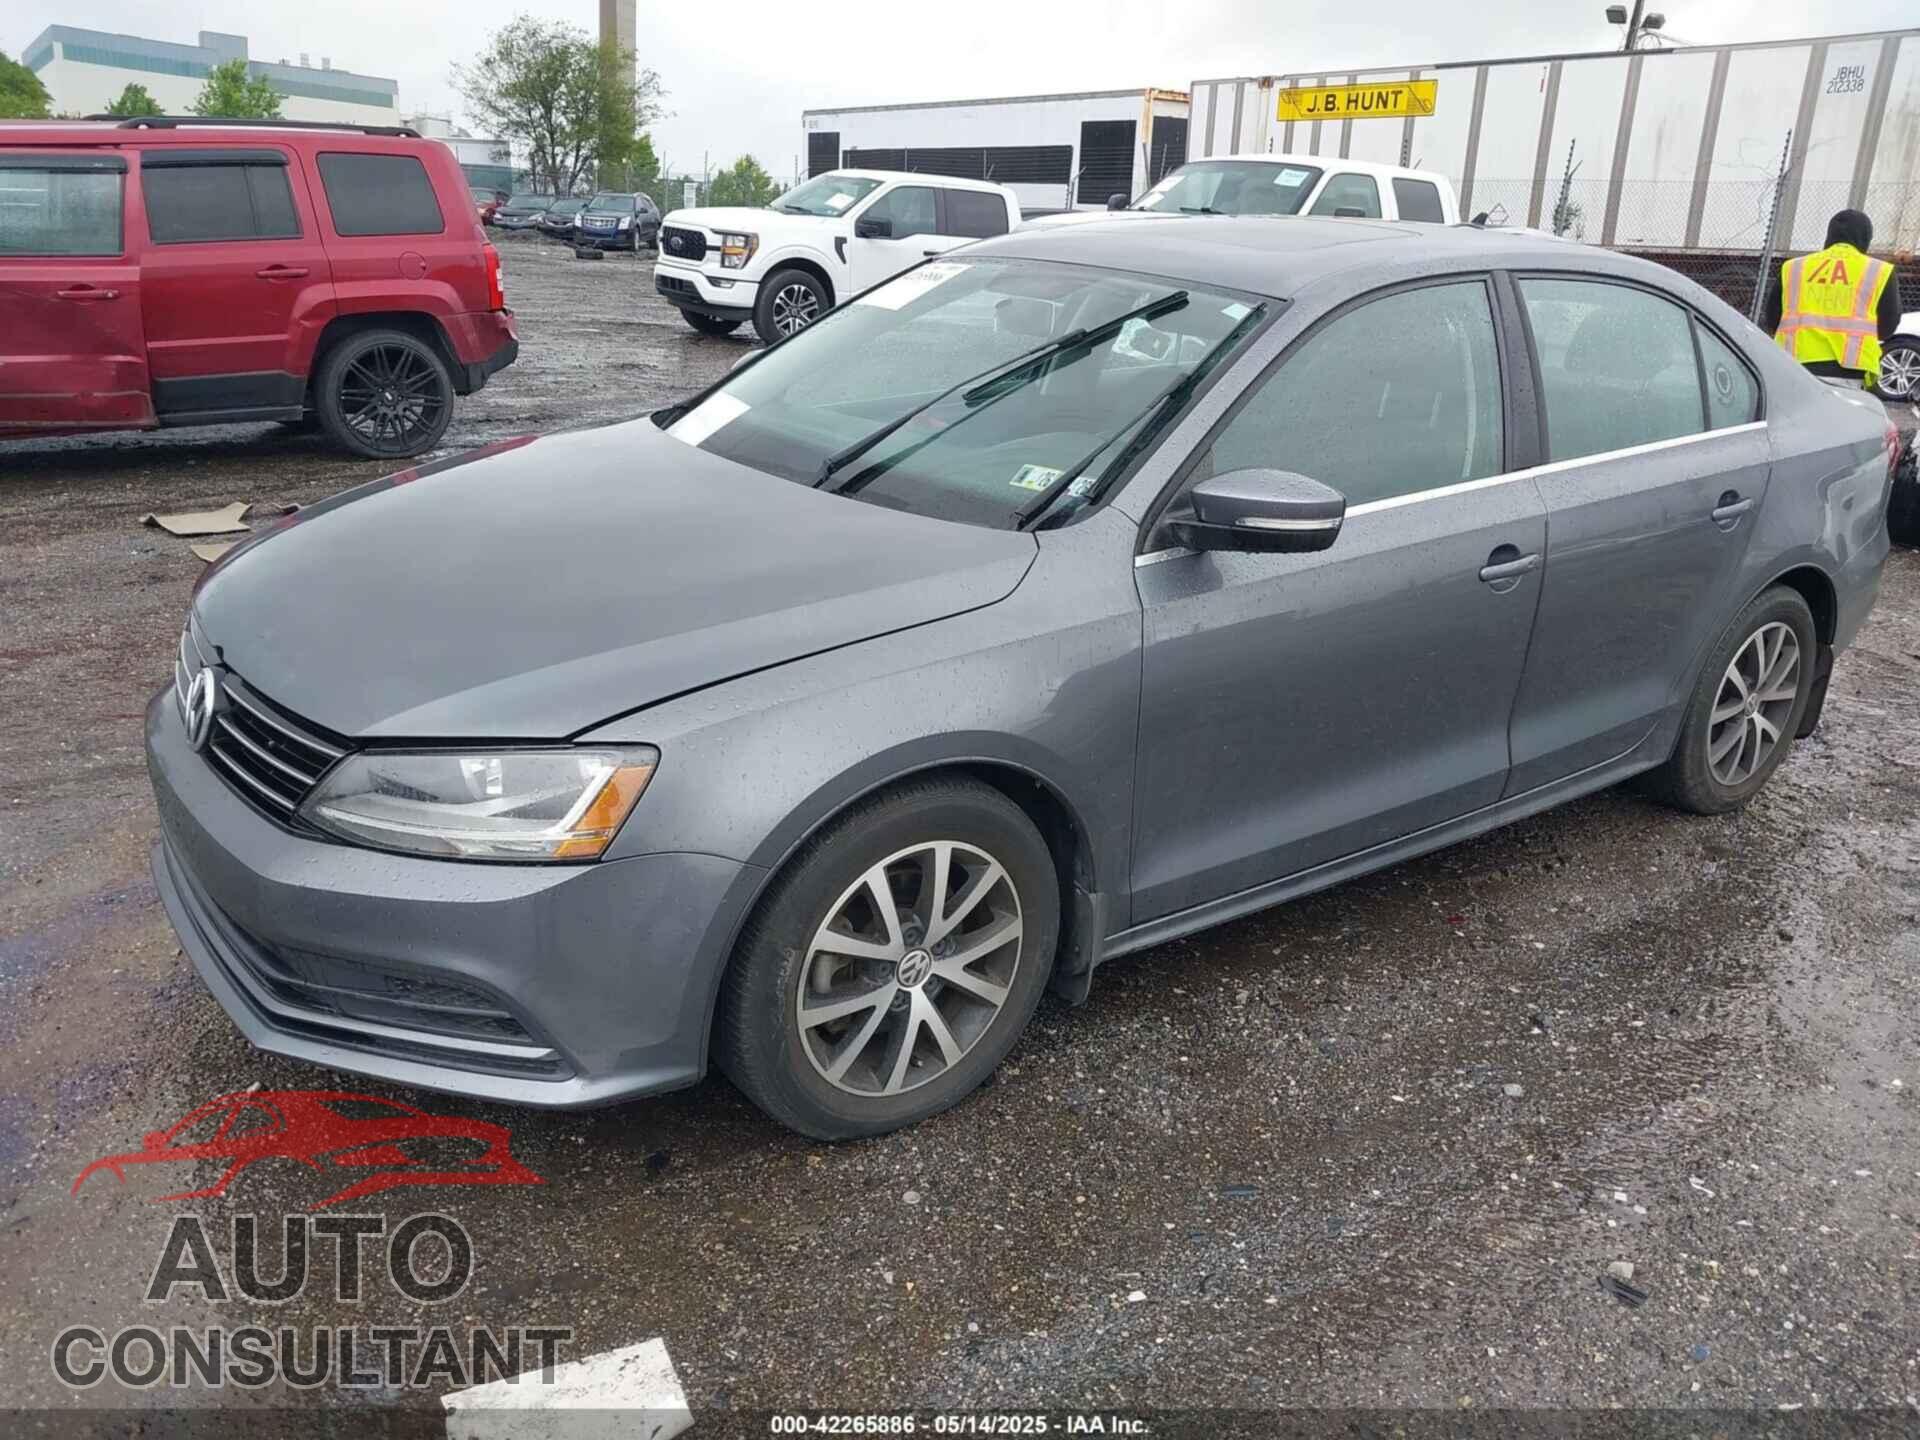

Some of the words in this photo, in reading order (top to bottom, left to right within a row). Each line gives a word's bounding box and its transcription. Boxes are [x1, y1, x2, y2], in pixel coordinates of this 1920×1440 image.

[1832, 65, 1865, 81] JBHU
[1826, 78, 1865, 95] 212338
[1345, 89, 1404, 111] HUNT
